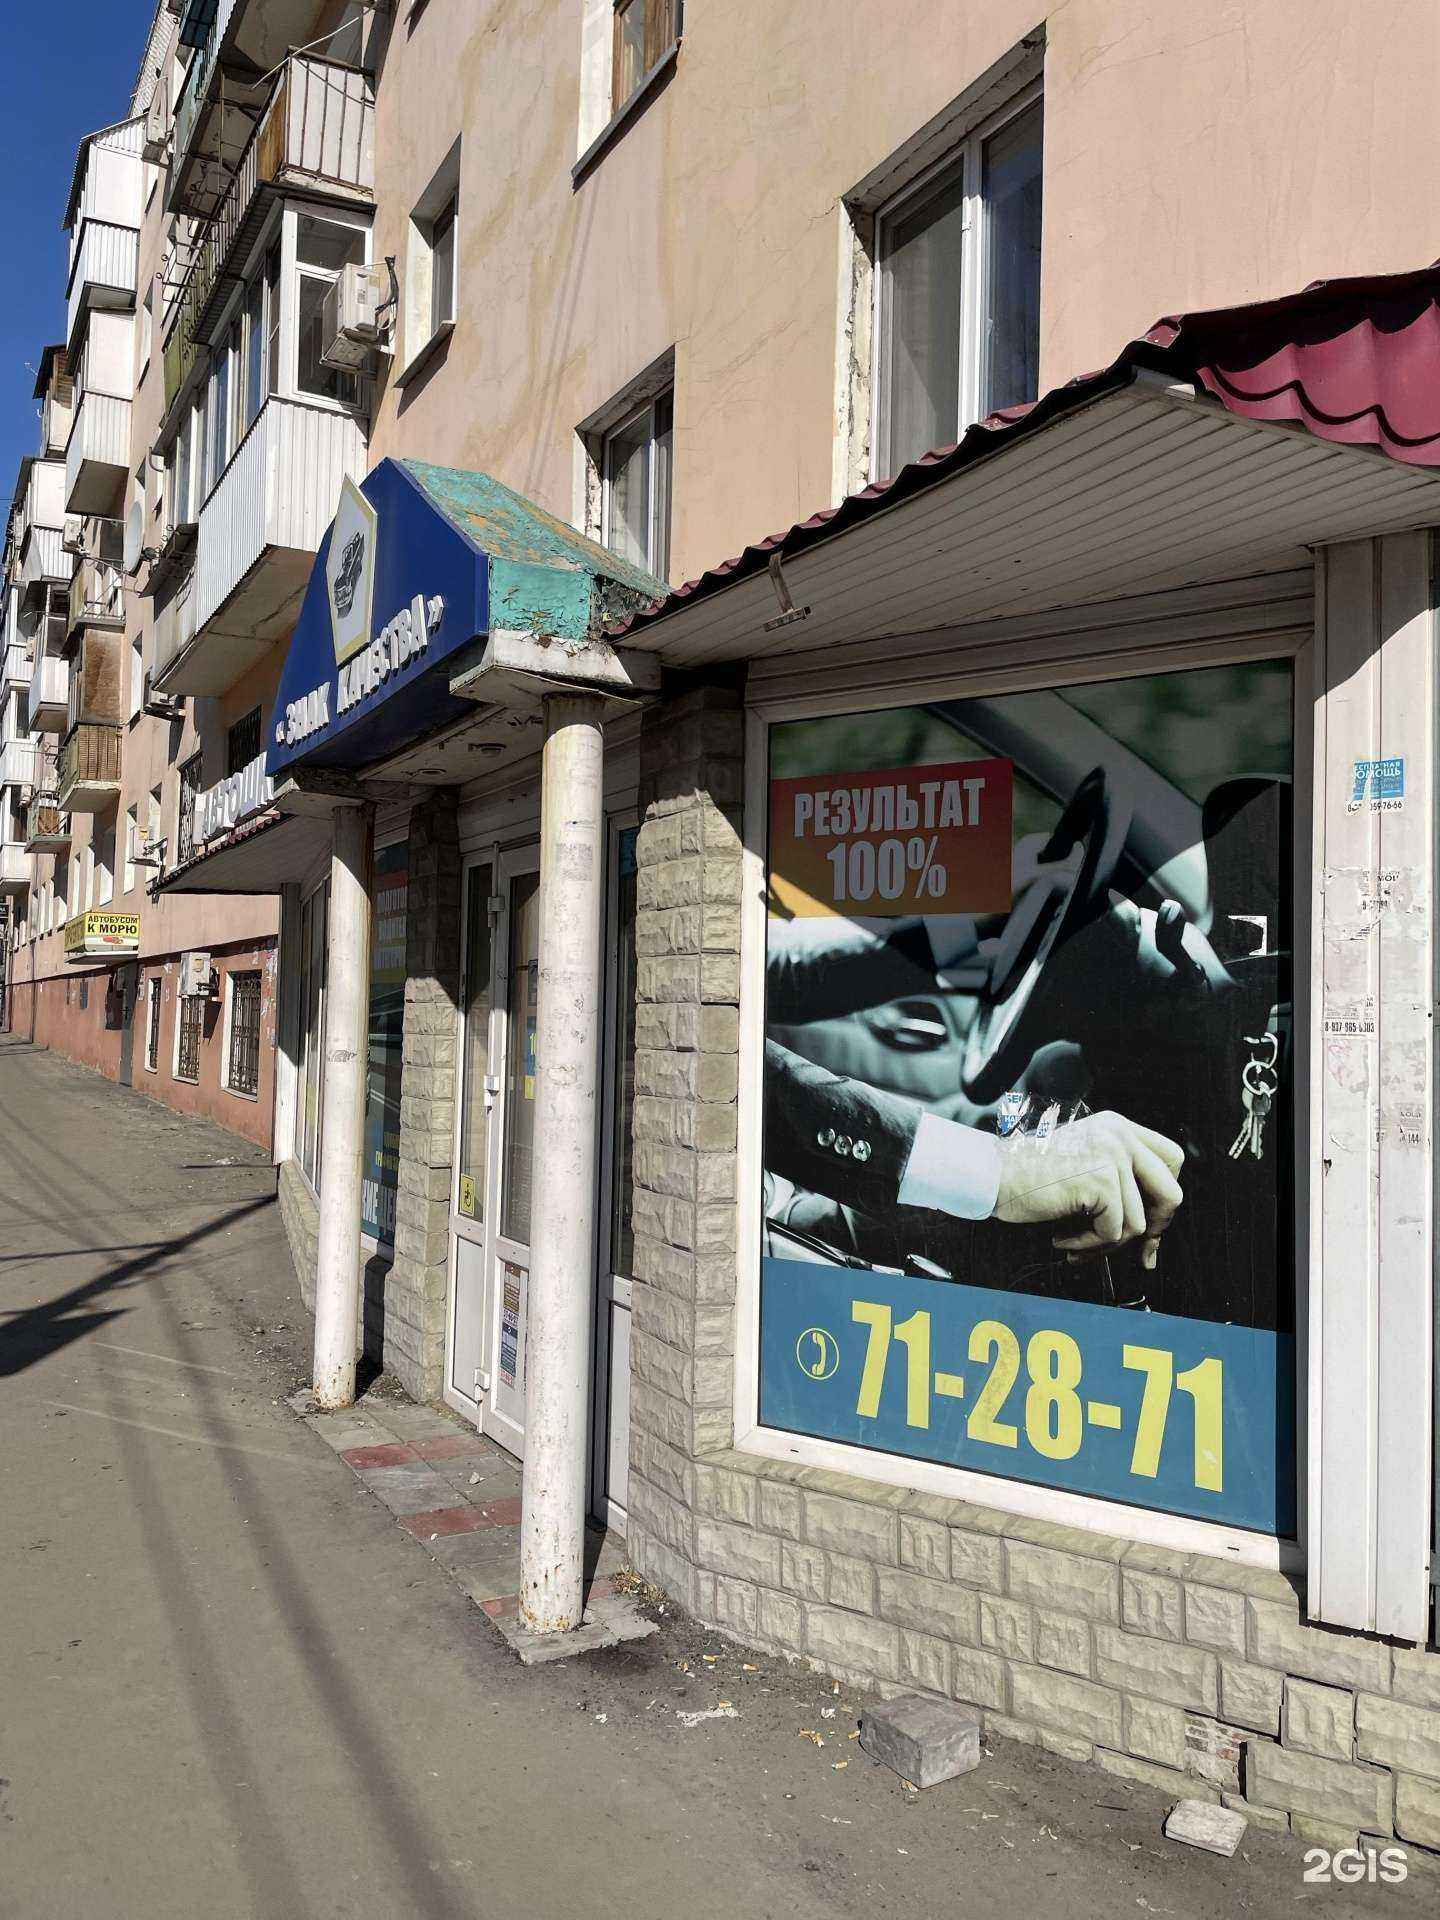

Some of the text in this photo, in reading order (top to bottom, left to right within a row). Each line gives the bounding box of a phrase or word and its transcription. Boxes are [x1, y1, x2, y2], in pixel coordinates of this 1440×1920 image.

[1353, 768, 1400, 779] ОМОЩЬ
[794, 778, 985, 837] РЕЗУЛЬТАТ
[826, 835, 947, 901] 100%
[87, 924, 137, 934] К МОРЮ
[88, 915, 138, 924] АВТОБУСОМ
[851, 1300, 1223, 1493] 71-28-71
